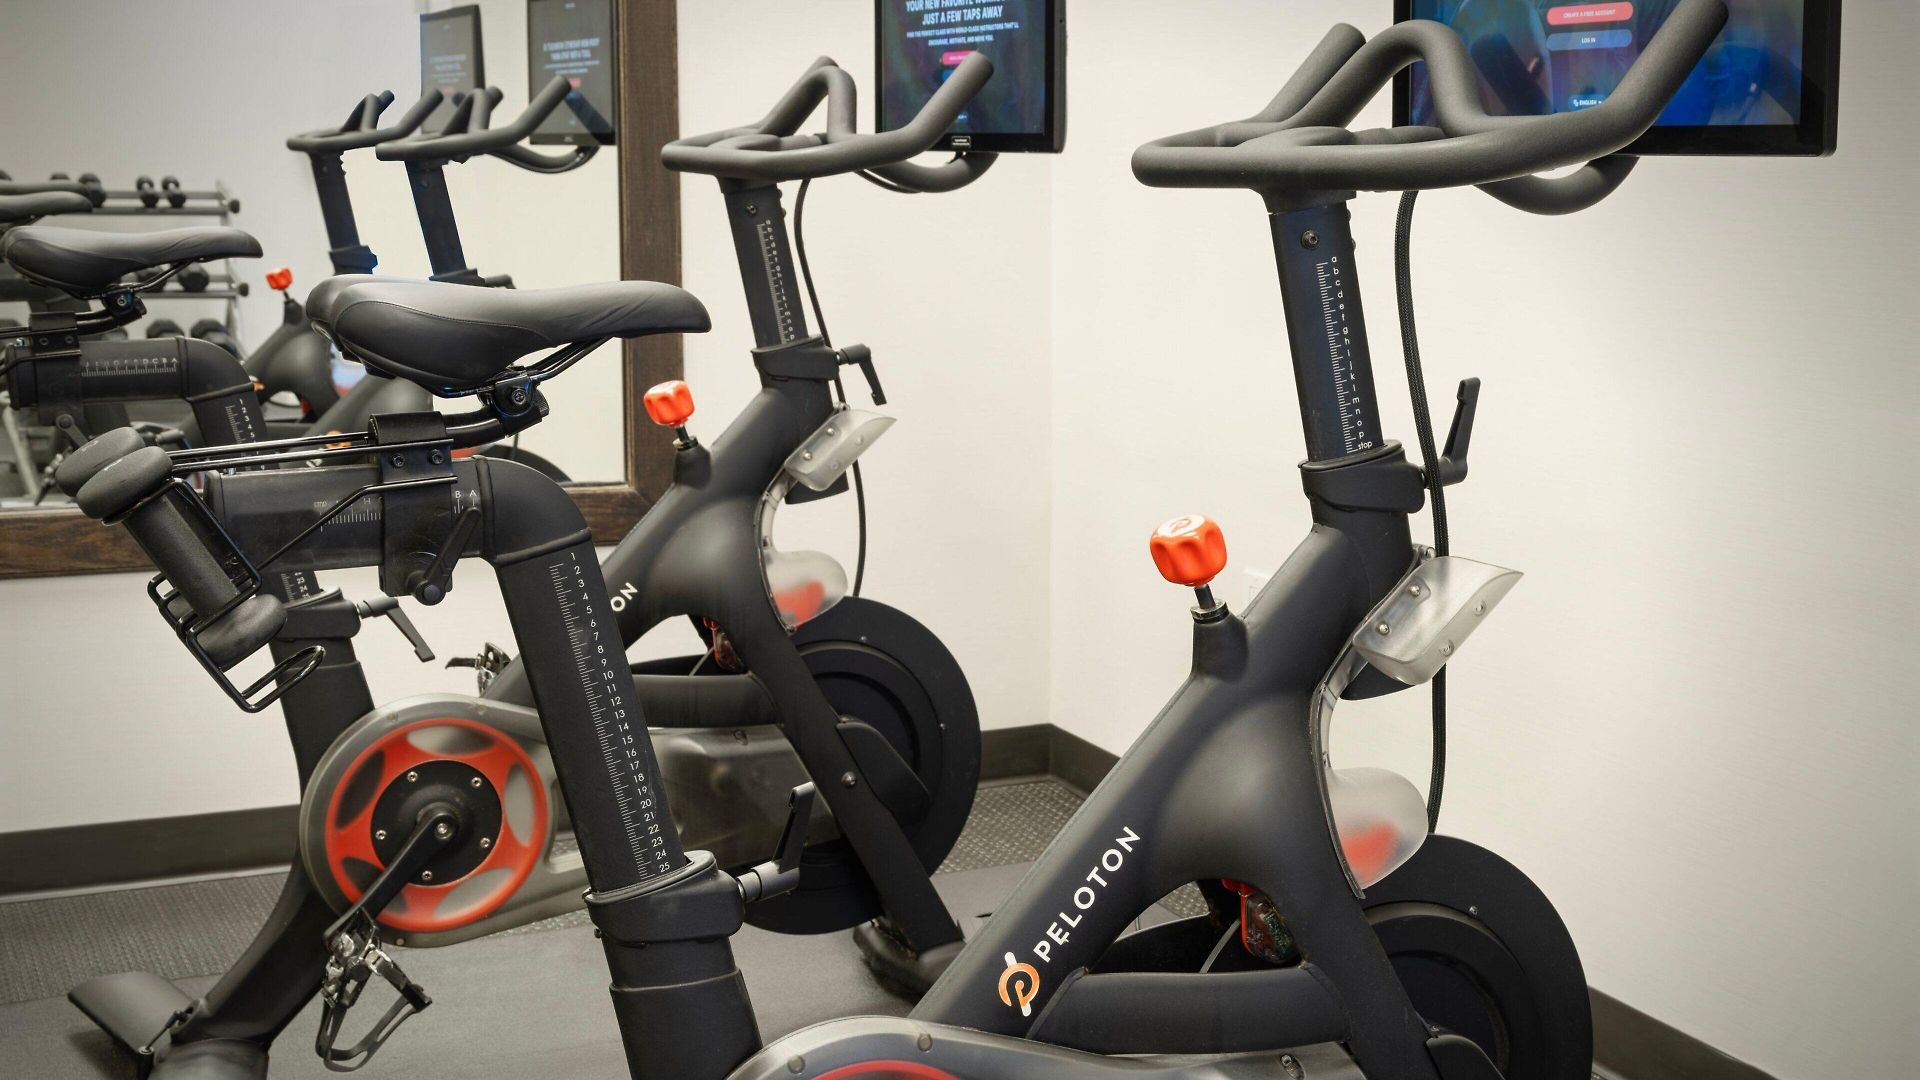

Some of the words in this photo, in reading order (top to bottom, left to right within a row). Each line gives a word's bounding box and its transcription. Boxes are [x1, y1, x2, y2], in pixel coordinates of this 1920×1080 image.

[906, 0, 924, 11] YOUR
[925, 0, 940, 10] NEW
[922, 12, 939, 25] JUST
[941, 12, 946, 23] A
[947, 10, 961, 22] FEW
[963, 8, 981, 20] TAPS
[982, 5, 1003, 19] AWAY
[1333, 267, 1339, 275] b
[1338, 290, 1343, 298] d
[1343, 326, 1348, 334] g
[1344, 337, 1350, 345] h
[1359, 431, 1364, 439] p
[1358, 441, 1372, 450] stop
[455, 490, 461, 498] B
[469, 489, 477, 497] A
[571, 552, 576, 560] 1
[574, 566, 581, 575] 2
[578, 579, 585, 588] 3
[583, 592, 589, 600] 4
[586, 606, 592, 614] 5
[591, 619, 596, 627] 6
[593, 632, 599, 640] 7
[598, 645, 604, 654] 8
[603, 671, 614, 681] 10
[606, 684, 617, 693] 11
[611, 697, 622, 706] 12
[614, 709, 626, 719] 13
[618, 722, 629, 732] 14
[622, 735, 633, 745] 15
[626, 748, 637, 758] 16
[630, 761, 640, 771] 17
[634, 773, 645, 783] 18
[637, 786, 648, 796] 19
[640, 799, 652, 808] 20
[644, 812, 655, 822] 21
[648, 824, 660, 834] 22
[651, 837, 663, 847] 23
[655, 849, 667, 860] 24
[659, 862, 670, 872] 25
[1033, 826, 1141, 963] PELOTON
